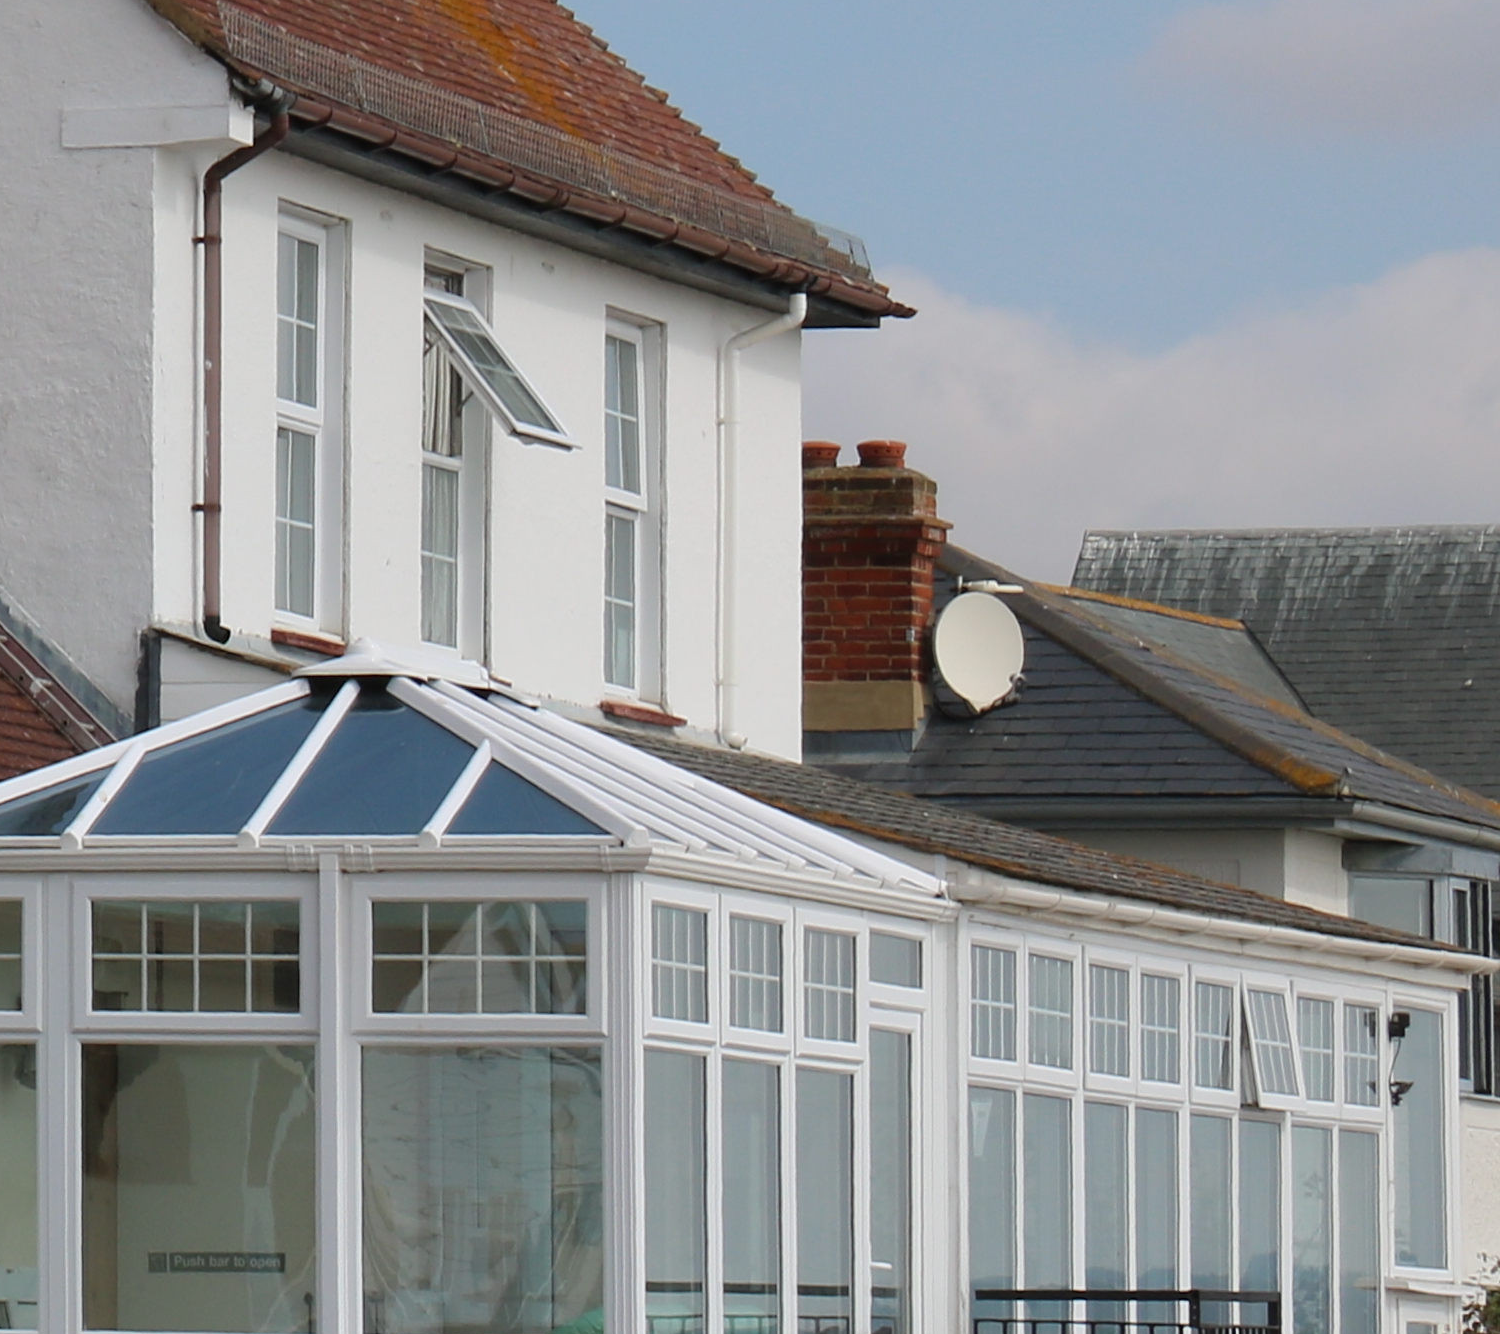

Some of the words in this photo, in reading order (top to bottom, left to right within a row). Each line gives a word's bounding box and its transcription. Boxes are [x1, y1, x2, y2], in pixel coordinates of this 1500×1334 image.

[173, 1254, 205, 1267] Push
[209, 1255, 230, 1267] bar
[233, 1255, 246, 1267] to
[249, 1256, 281, 1270] open
